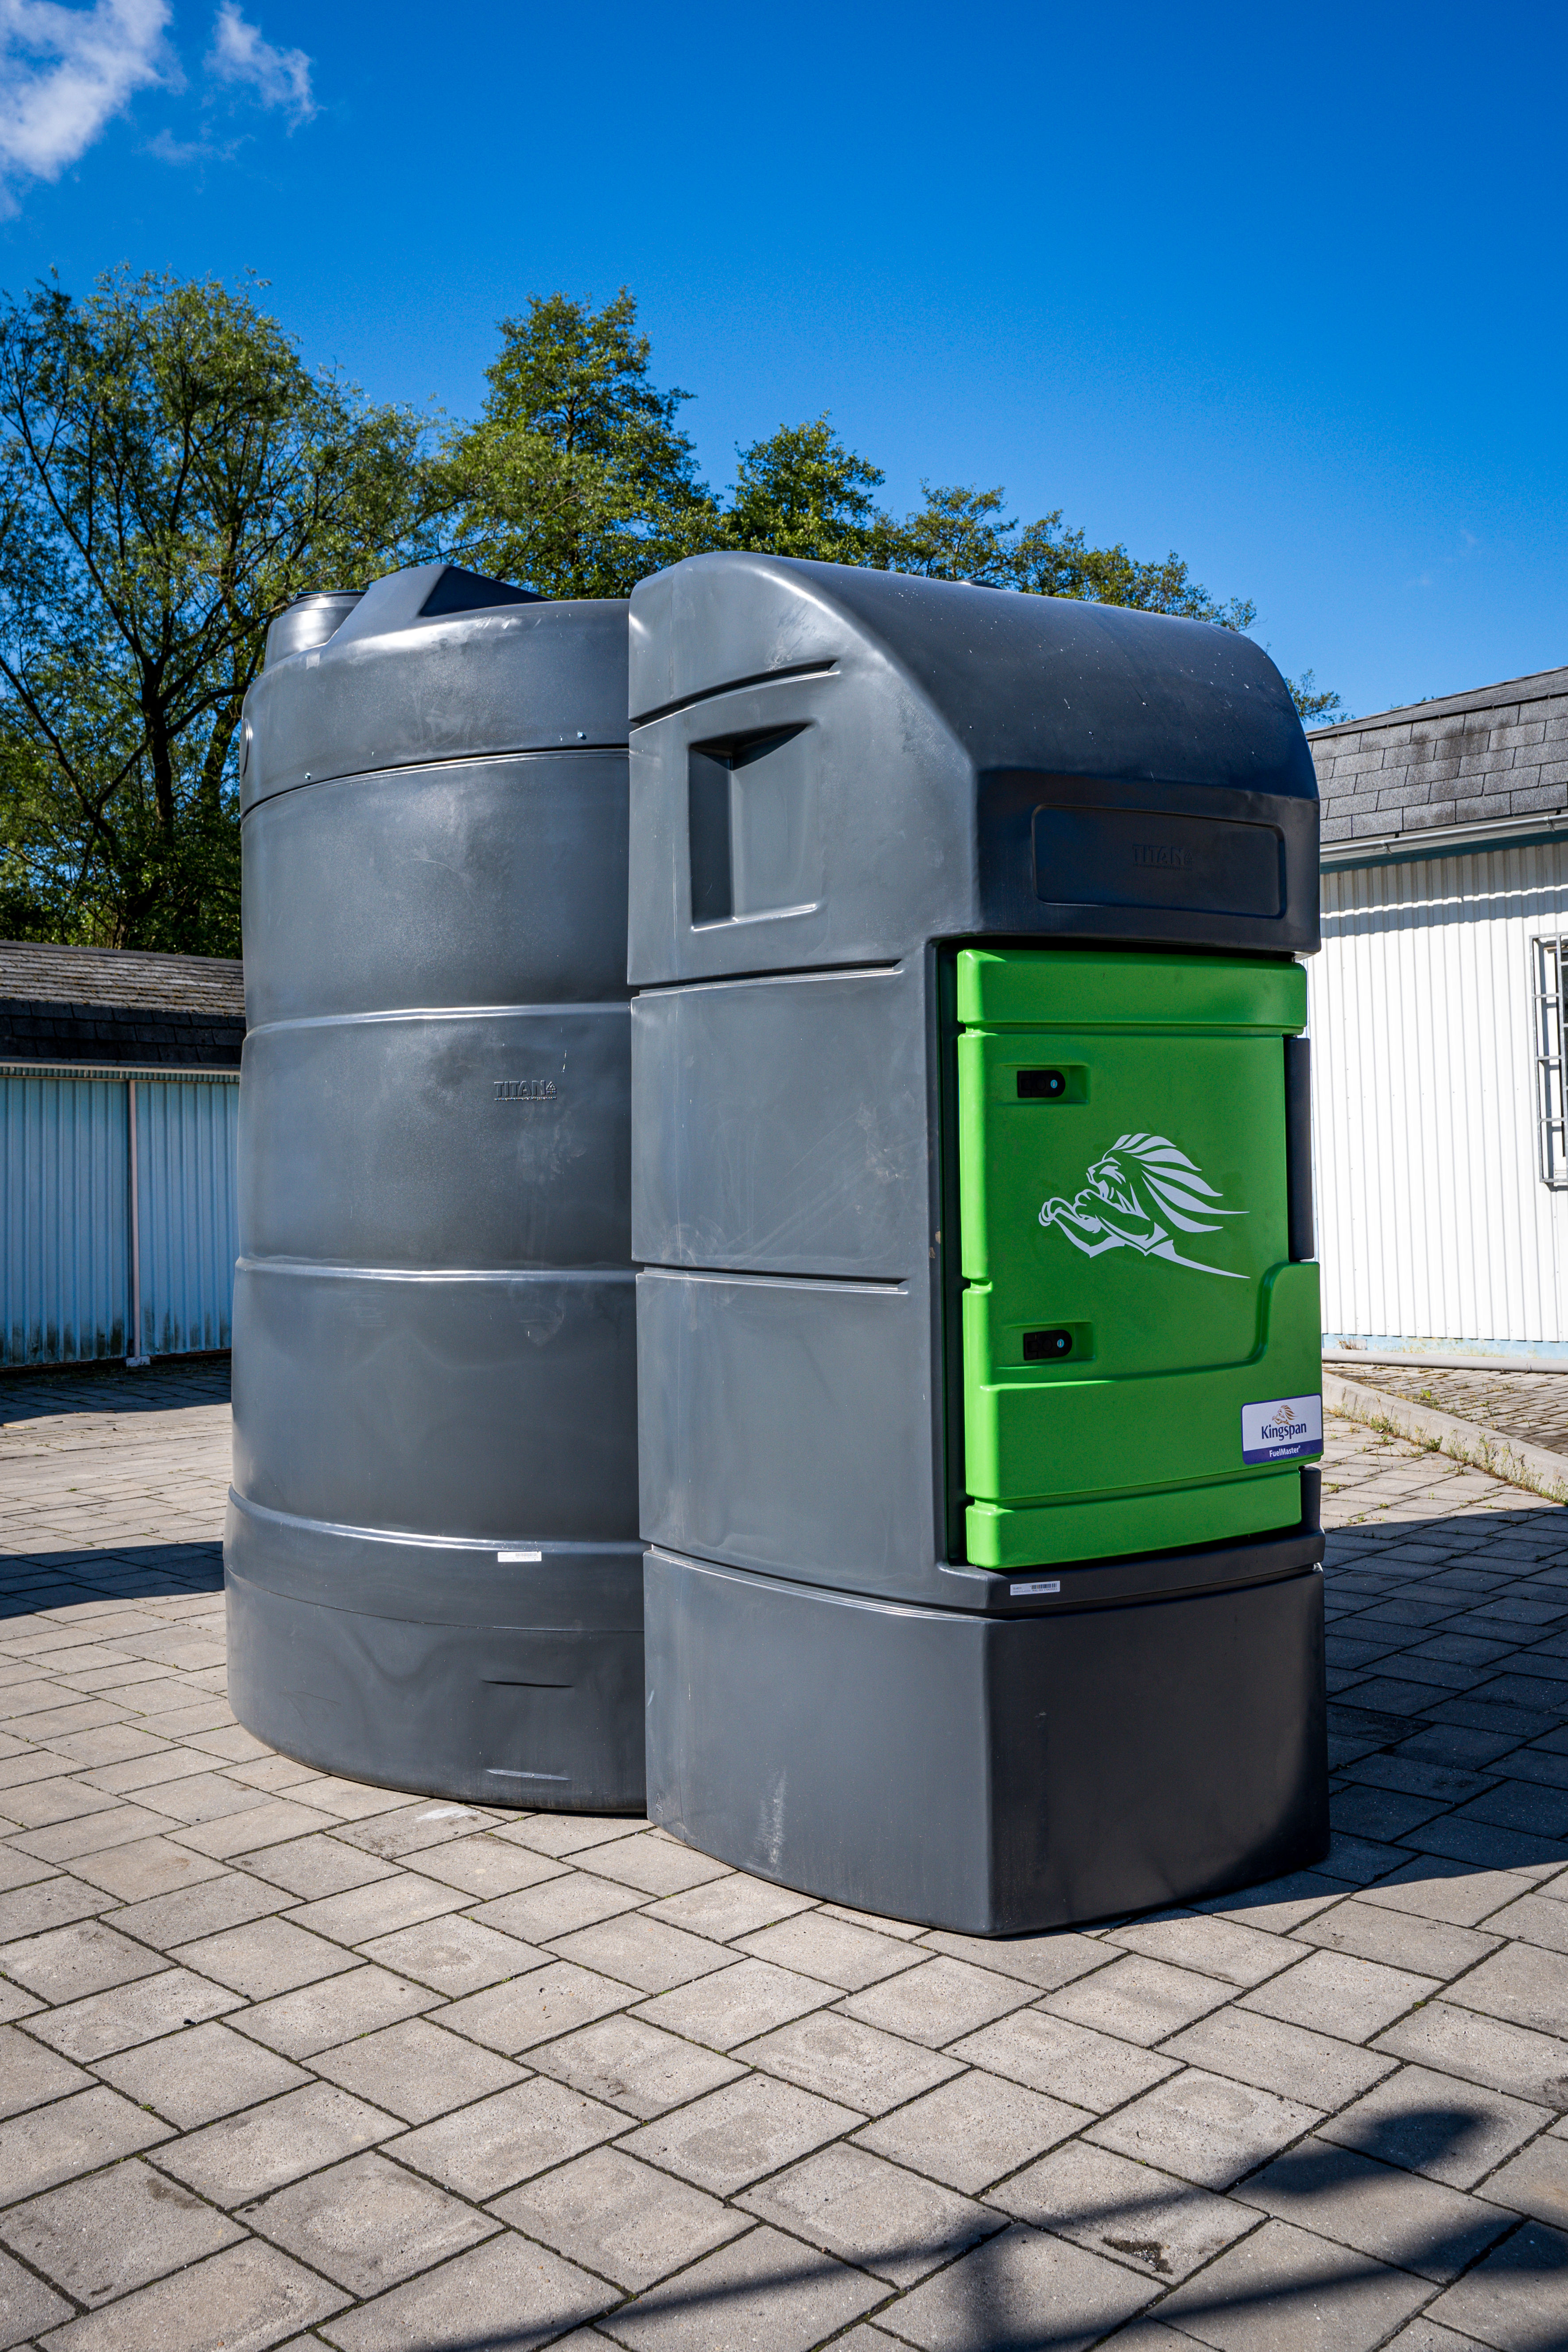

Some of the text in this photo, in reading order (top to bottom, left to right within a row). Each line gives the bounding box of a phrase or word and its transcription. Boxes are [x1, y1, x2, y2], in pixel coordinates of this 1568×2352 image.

[1133, 844, 1184, 865] TITAN
[493, 1080, 546, 1097] TITAN
[1261, 1423, 1307, 1441] Kingspan
